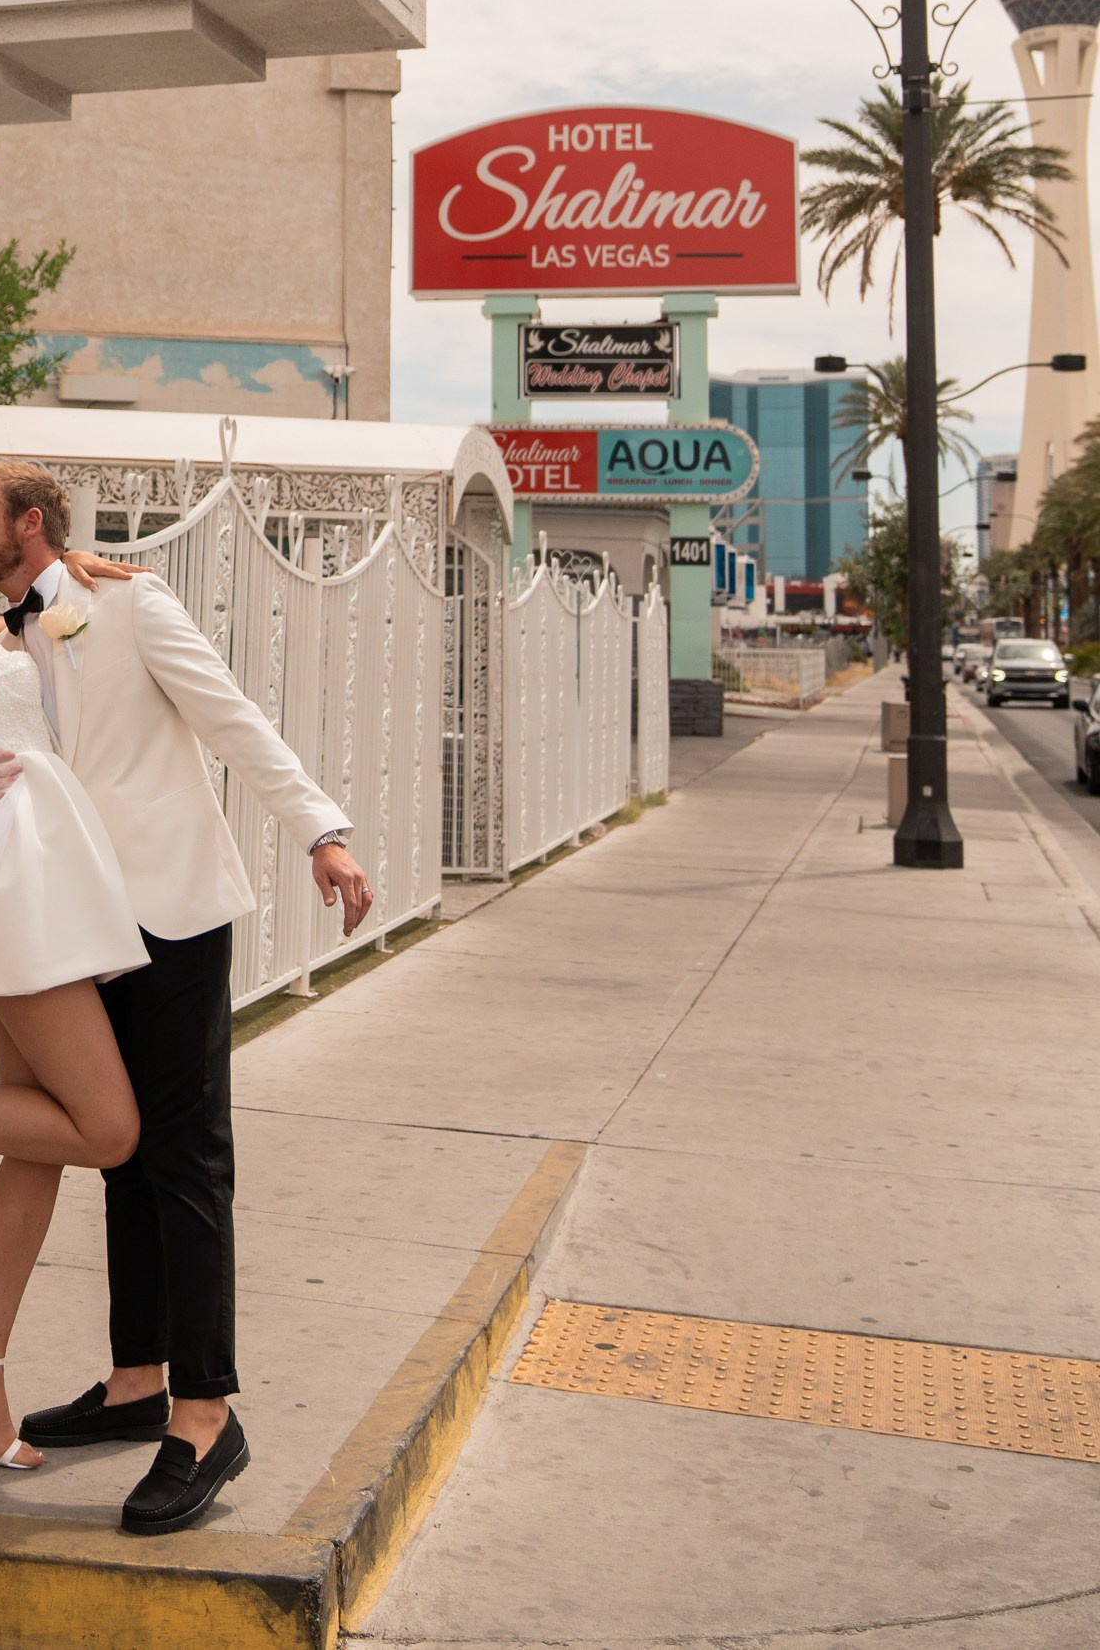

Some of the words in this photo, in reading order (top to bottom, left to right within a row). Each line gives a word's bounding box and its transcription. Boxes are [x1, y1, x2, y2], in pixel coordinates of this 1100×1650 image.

[547, 123, 654, 153] HOTEL
[438, 144, 768, 242] Shalimar
[531, 246, 579, 269] LAS
[583, 244, 671, 269] VEGAS
[548, 329, 651, 356] Shalimar
[529, 363, 603, 393] Wedding
[608, 362, 669, 391] Chapel
[608, 439, 732, 473] AQUA
[505, 464, 582, 489] OTEL
[607, 477, 658, 486] BREAKFAST
[664, 477, 693, 486] LUNCH
[672, 541, 710, 562] 1401
